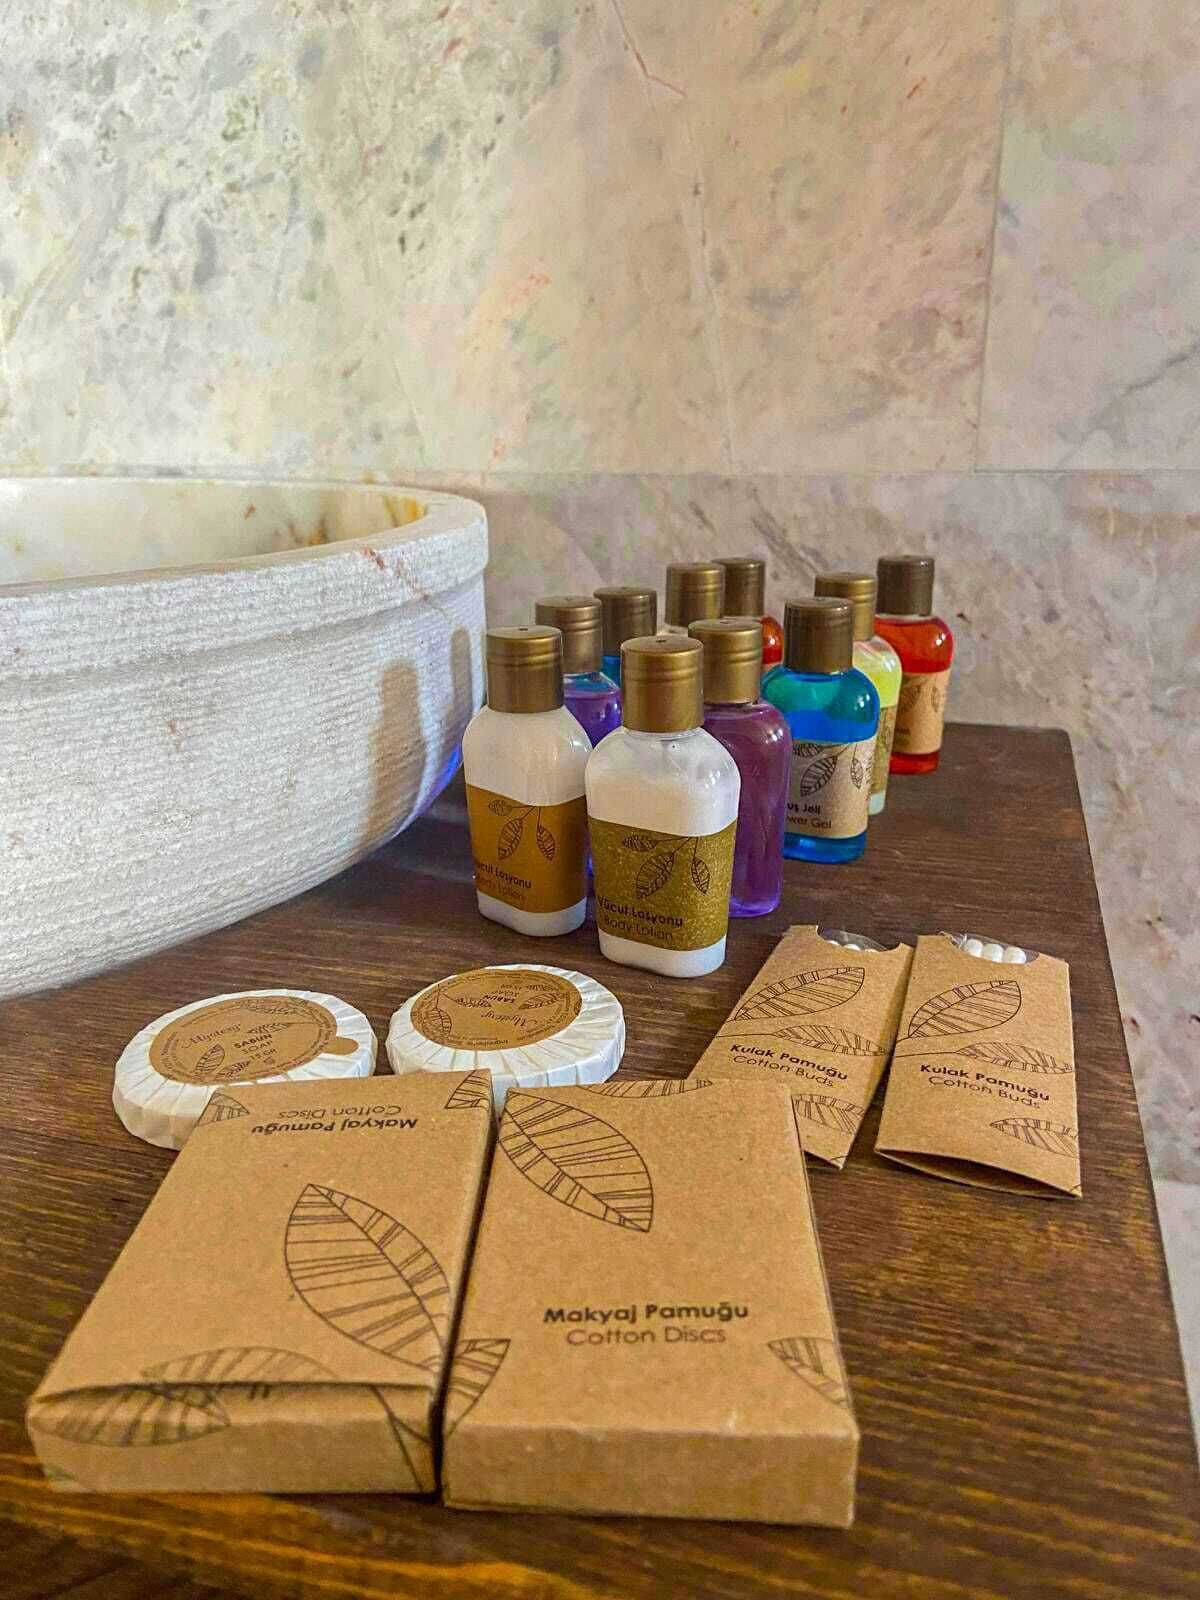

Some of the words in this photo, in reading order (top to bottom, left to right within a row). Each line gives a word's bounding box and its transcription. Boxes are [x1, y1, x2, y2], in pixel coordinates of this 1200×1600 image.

[632, 906, 683, 929] Losyonu
[635, 923, 674, 942] Lotion
[233, 1034, 273, 1049] SABUN
[729, 1044, 775, 1058] Kulak
[780, 1052, 848, 1080] Pamuğu
[733, 1055, 790, 1073] Cotton
[795, 1067, 834, 1087] Buds
[920, 1064, 969, 1079] Kulak
[975, 1072, 1050, 1101] Pamuğu
[928, 1076, 993, 1095] Cotton
[998, 1089, 1041, 1109] Buds
[277, 1108, 327, 1119] Discs
[333, 1105, 402, 1118] Cotton
[251, 1121, 336, 1135] Pamuğu
[340, 1118, 418, 1131] Makyaj
[543, 1304, 637, 1325] Makyaj
[645, 1302, 748, 1322] Pamuğu
[566, 1328, 656, 1346] Cotton
[664, 1326, 727, 1344] Discs
